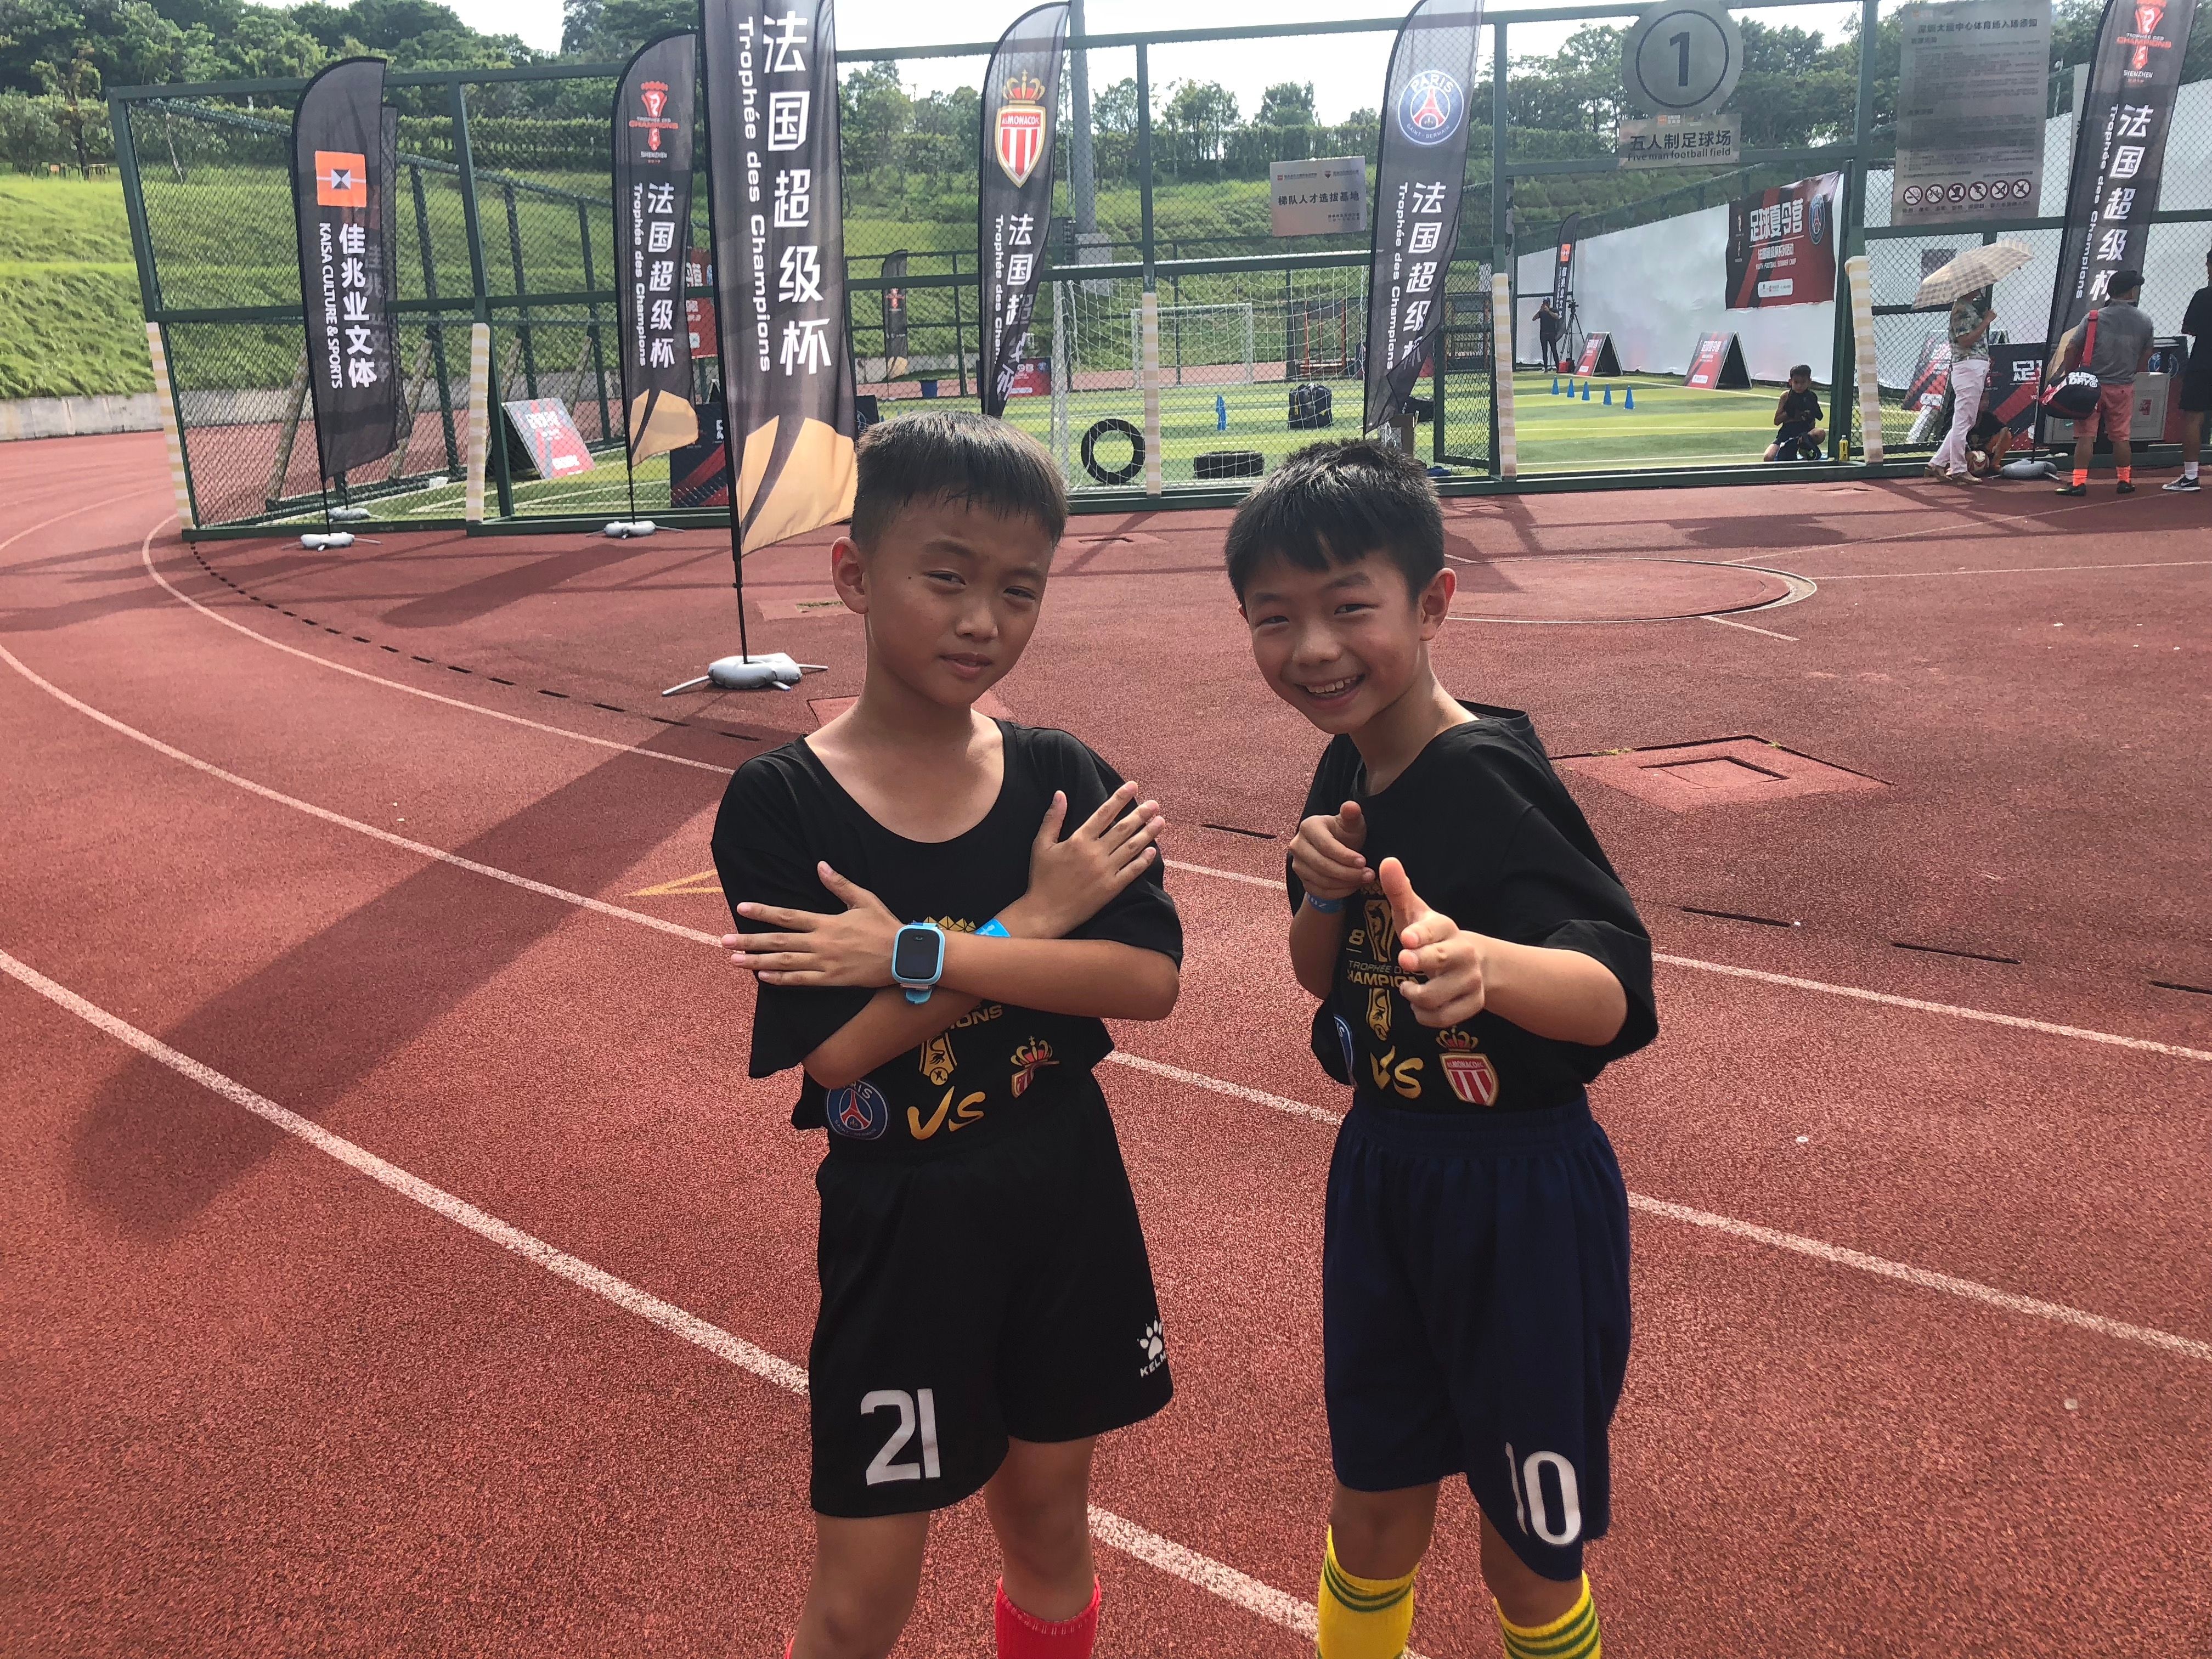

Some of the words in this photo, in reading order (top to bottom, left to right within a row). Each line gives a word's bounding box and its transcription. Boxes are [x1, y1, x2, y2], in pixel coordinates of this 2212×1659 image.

[738, 16, 760, 139] Trophée
[1410, 74, 1454, 93] PARIS
[1669, 31, 1690, 86] 1
[1007, 115, 1036, 125] MONACO
[1630, 130, 1731, 151] 五人制足球场
[747, 151, 761, 202] des
[1671, 149, 1707, 159] football
[1710, 147, 1730, 157] field
[633, 183, 644, 246] Trophée
[763, 10, 831, 376] 法国超级杯
[1278, 191, 1359, 206] 梯队人才选拔基地
[1395, 182, 1408, 247] Trophée
[1750, 198, 1804, 241] 足球夏令营
[319, 222, 332, 263] KAISA
[635, 251, 644, 278] des
[994, 214, 1005, 279] Trophée
[1393, 252, 1402, 280] des
[2075, 210, 2098, 299] Champions
[322, 265, 337, 324] CULTURE
[648, 182, 675, 368] 法国超级杯
[751, 214, 771, 372] Champions
[995, 284, 1003, 312] des
[326, 325, 338, 336] &
[339, 223, 377, 388] 佳兆业文体
[636, 283, 646, 366] Champions
[1386, 286, 1401, 370] Champions
[328, 338, 342, 389] SPORTS
[1348, 929, 1365, 945] 8
[1370, 1045, 1424, 1099] VS
[907, 1086, 986, 1140] VS
[1140, 1351, 1166, 1378] KELM
[860, 1388, 941, 1486] 21
[1505, 1442, 1582, 1546] 10
